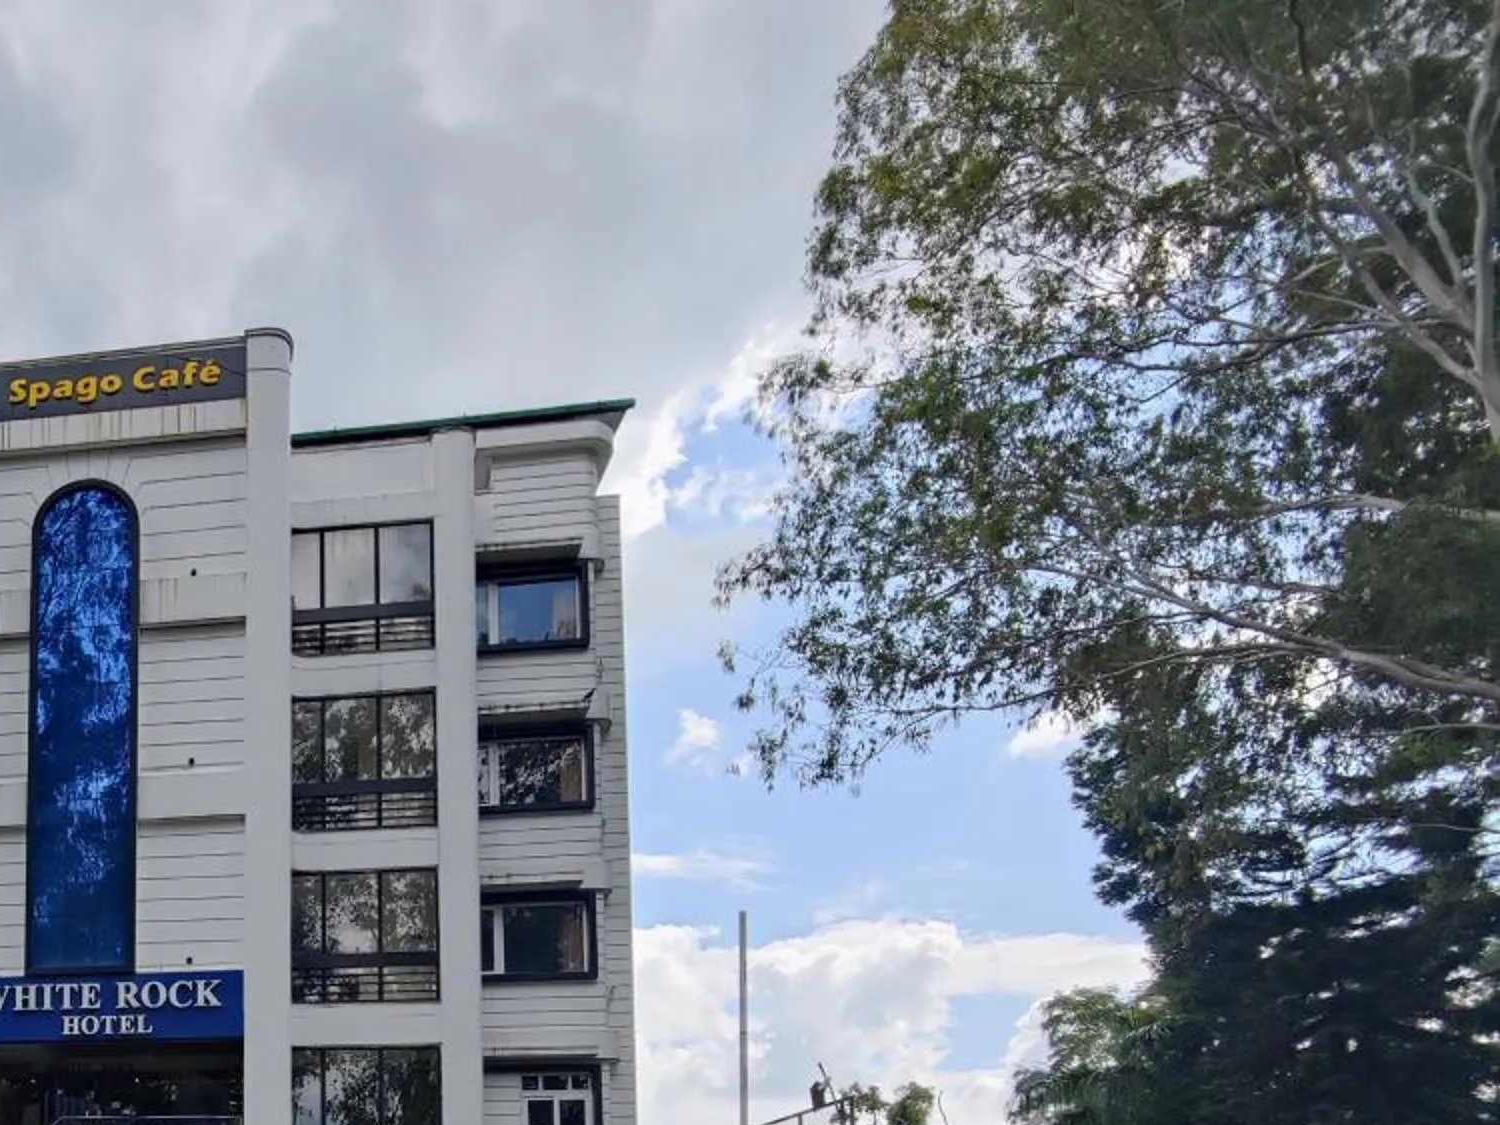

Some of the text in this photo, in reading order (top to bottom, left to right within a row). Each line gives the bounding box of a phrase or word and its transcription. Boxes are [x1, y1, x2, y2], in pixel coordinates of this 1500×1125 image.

[8, 358, 221, 408] Spago Café
[116, 979, 223, 1009] ROCK
[62, 1014, 153, 1036] HOTEL
